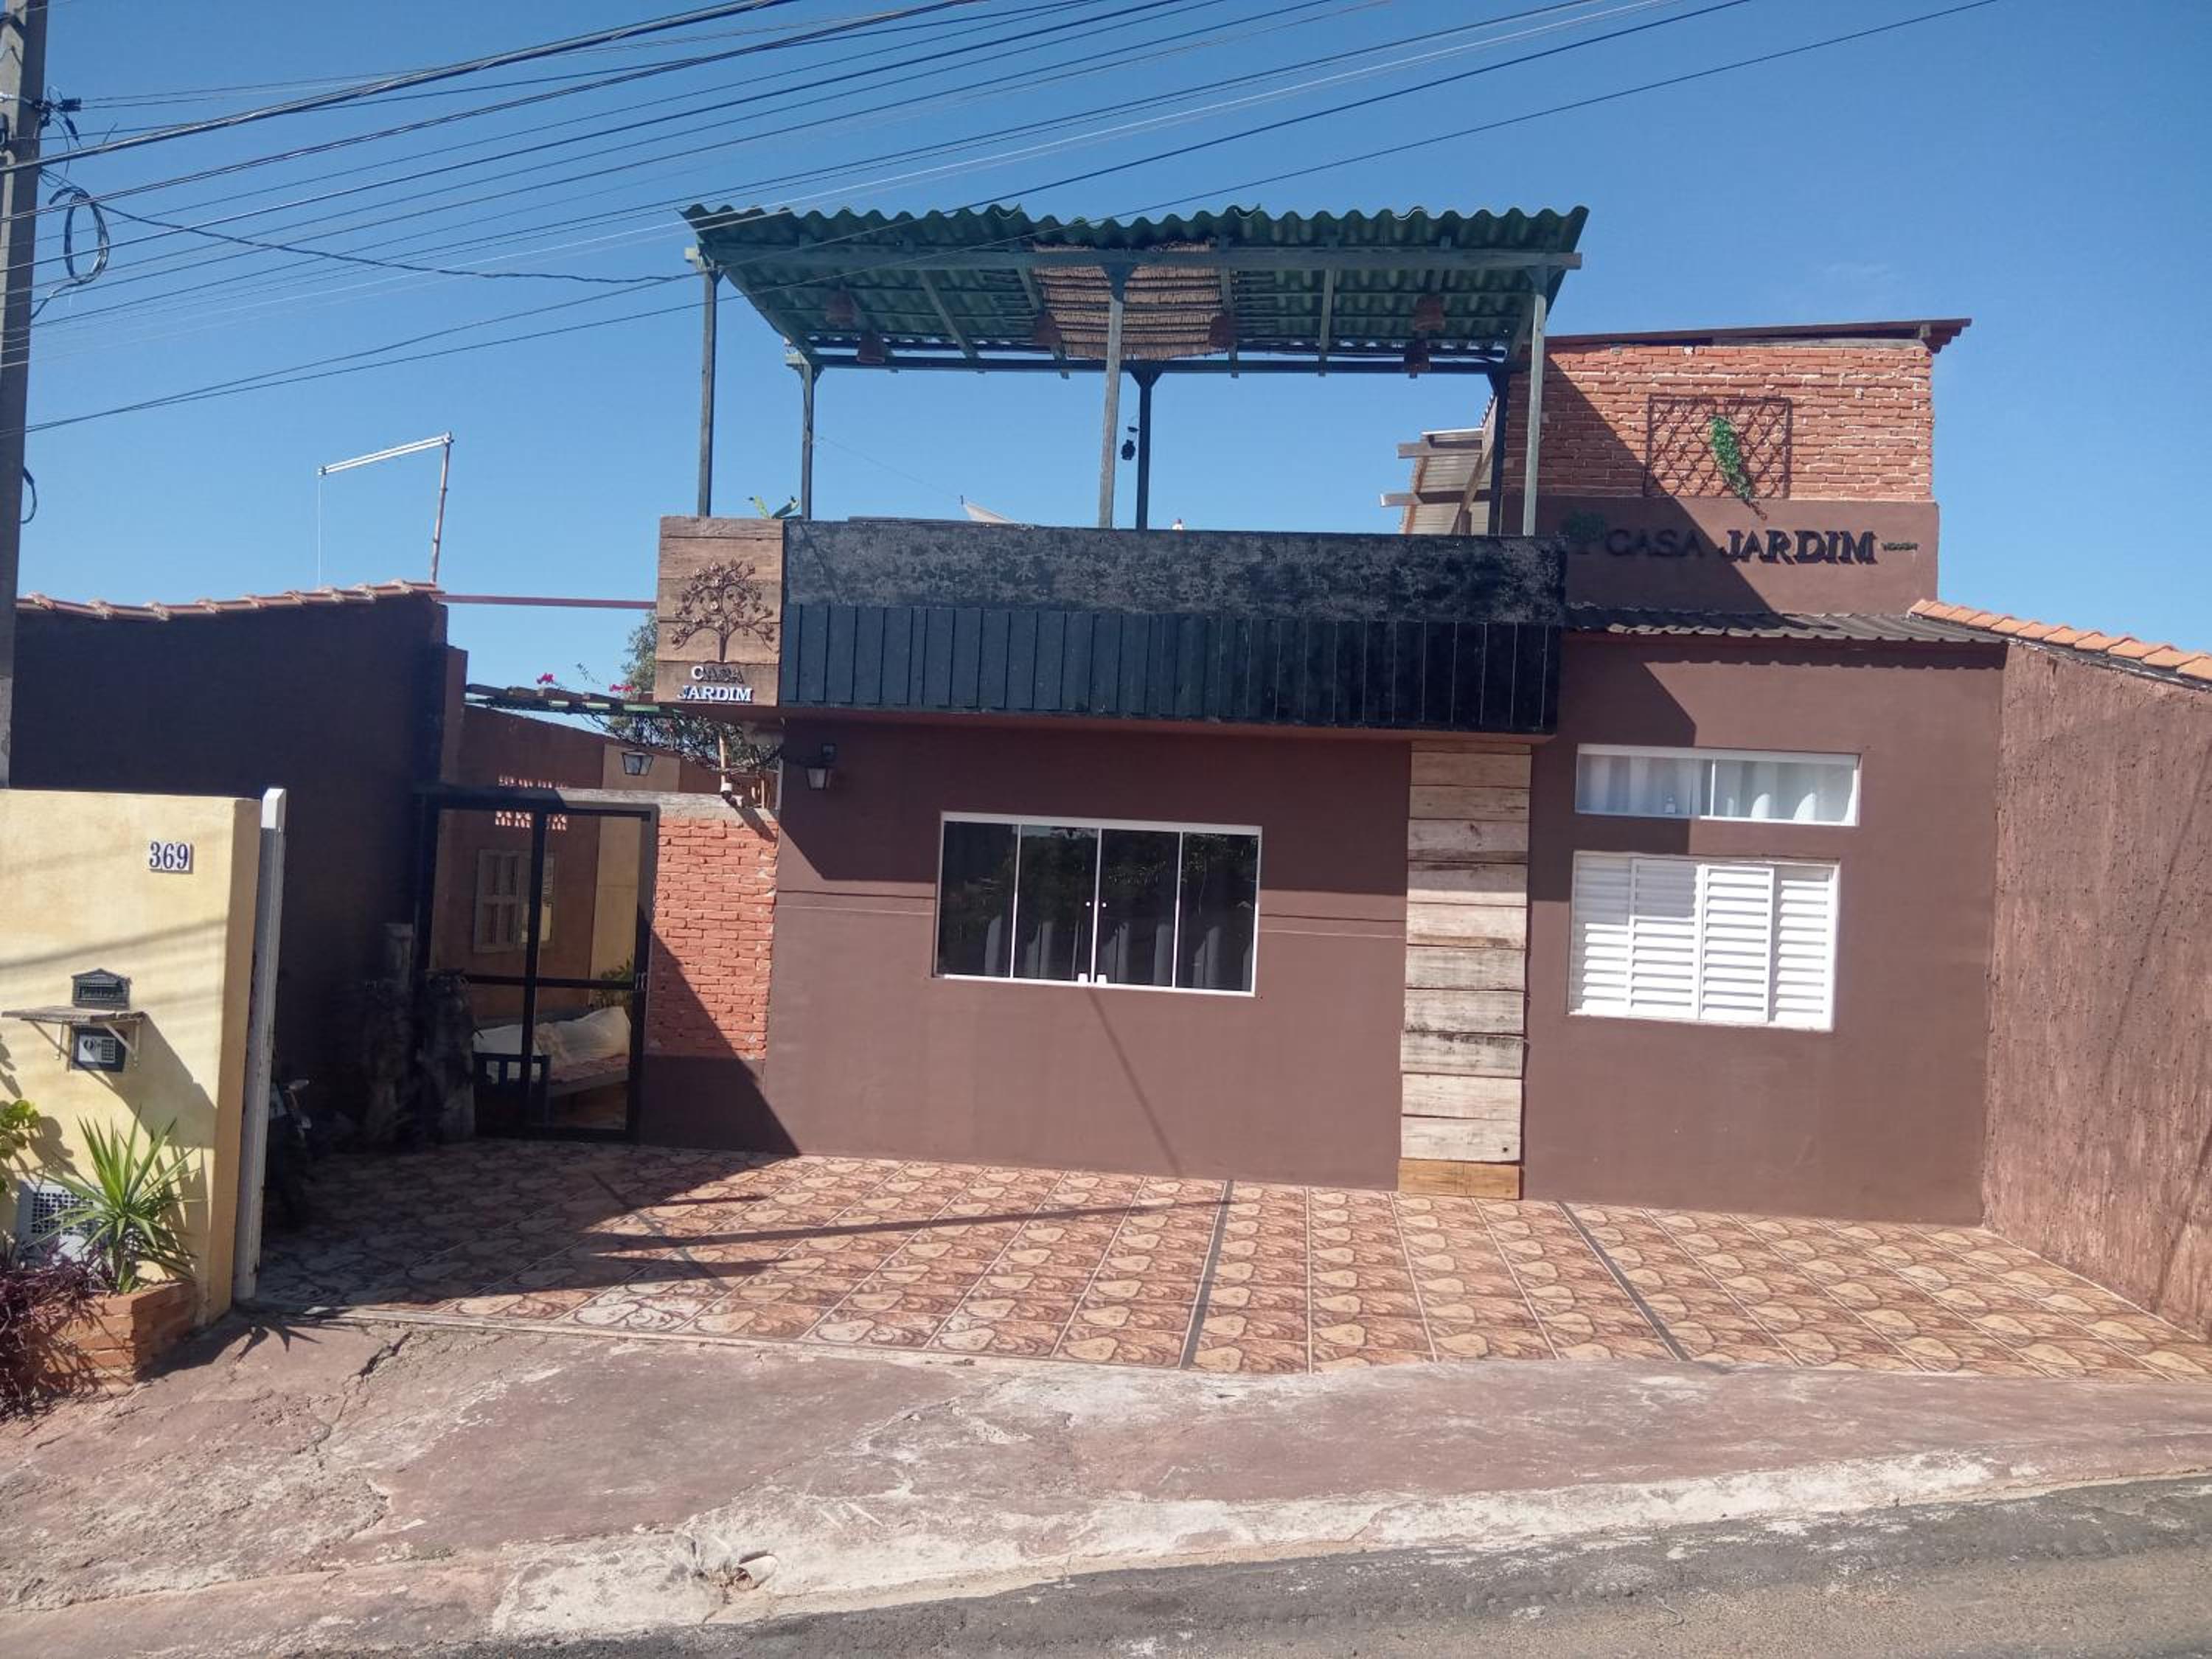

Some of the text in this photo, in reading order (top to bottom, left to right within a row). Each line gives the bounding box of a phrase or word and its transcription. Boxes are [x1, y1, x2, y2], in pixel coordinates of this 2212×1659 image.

[1604, 529, 1878, 565] CASA JARDIM
[691, 665, 744, 684] CASA
[677, 685, 753, 702] JARDIM
[149, 841, 188, 869] 369
